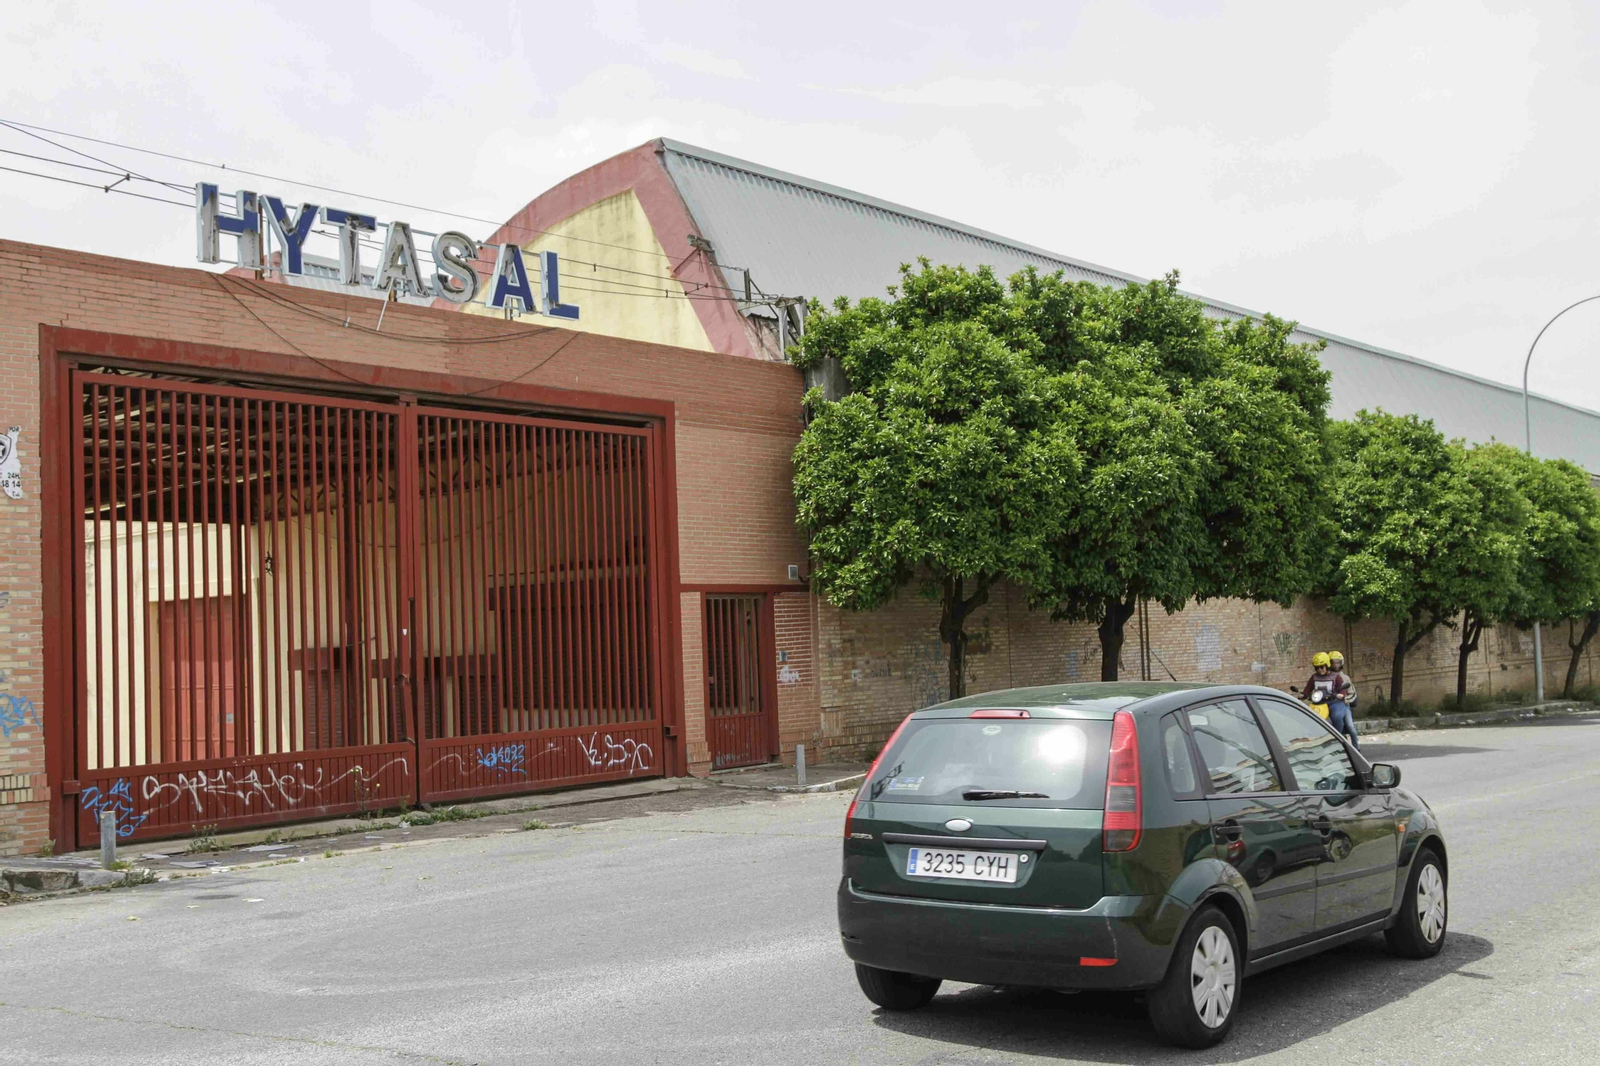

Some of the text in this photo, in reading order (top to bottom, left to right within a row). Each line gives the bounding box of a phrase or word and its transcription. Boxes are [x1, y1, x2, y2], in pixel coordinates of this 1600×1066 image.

[196, 182, 580, 321] HYTASAL
[923, 852, 1009, 878] 3235 CYH
